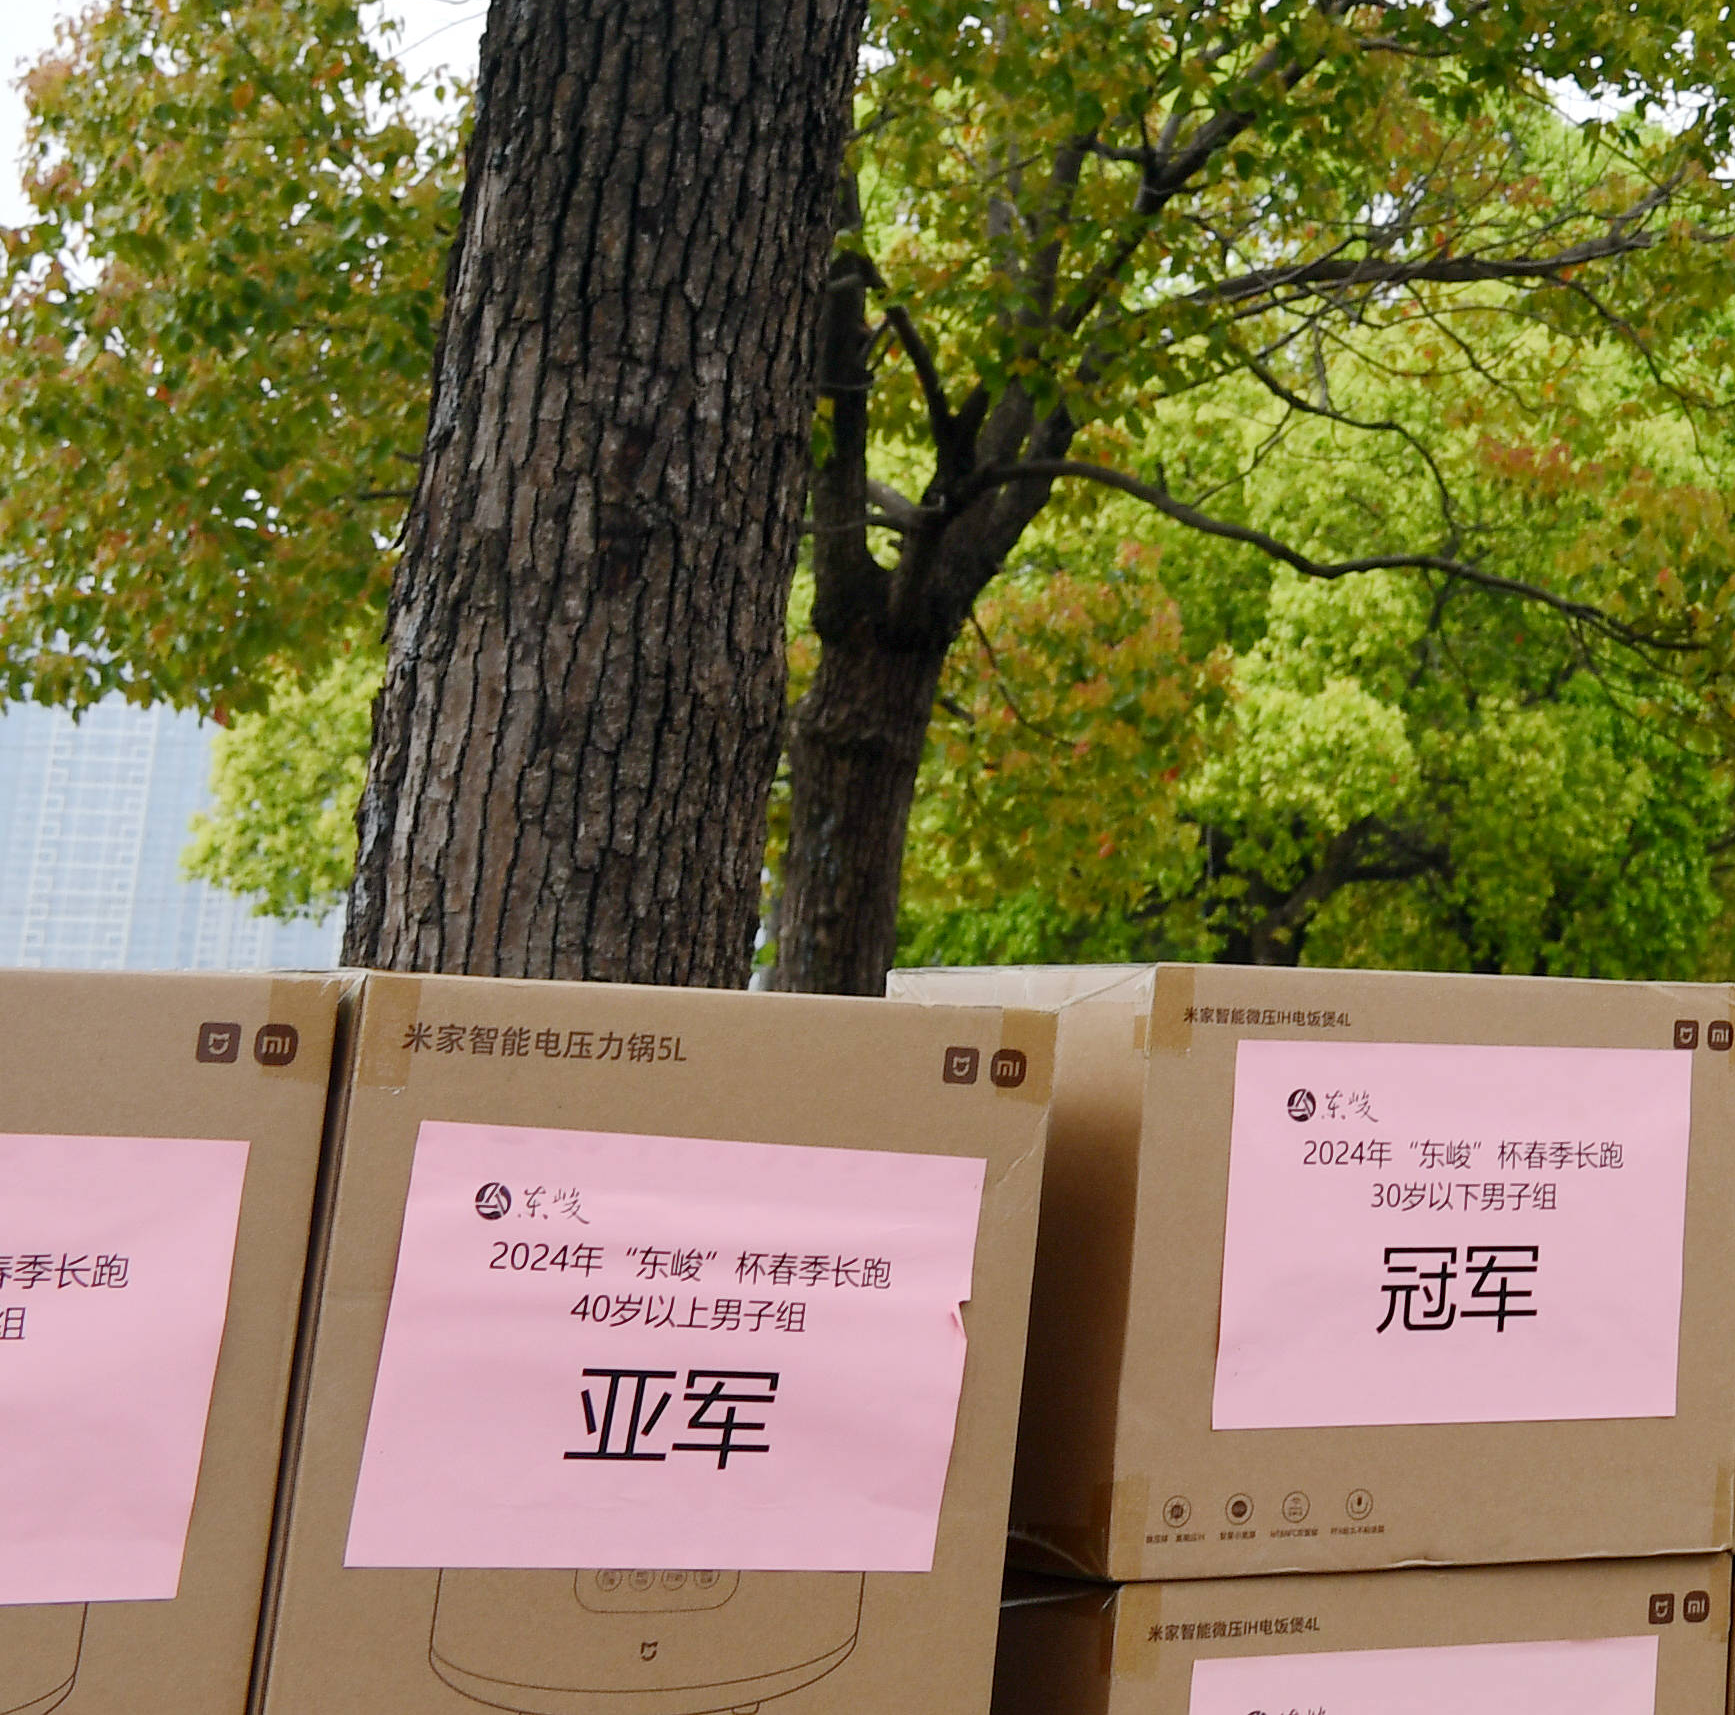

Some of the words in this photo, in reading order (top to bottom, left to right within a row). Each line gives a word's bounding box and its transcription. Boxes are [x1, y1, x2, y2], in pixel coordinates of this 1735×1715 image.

[401, 1022, 688, 1063] 米家智能电压力锅5L
[1370, 1181, 1557, 1212] 30岁以下男子组
[1375, 1245, 1540, 1335] 冠军
[569, 1294, 807, 1333] 40岁以上男子组
[562, 1368, 781, 1471] 亚军
